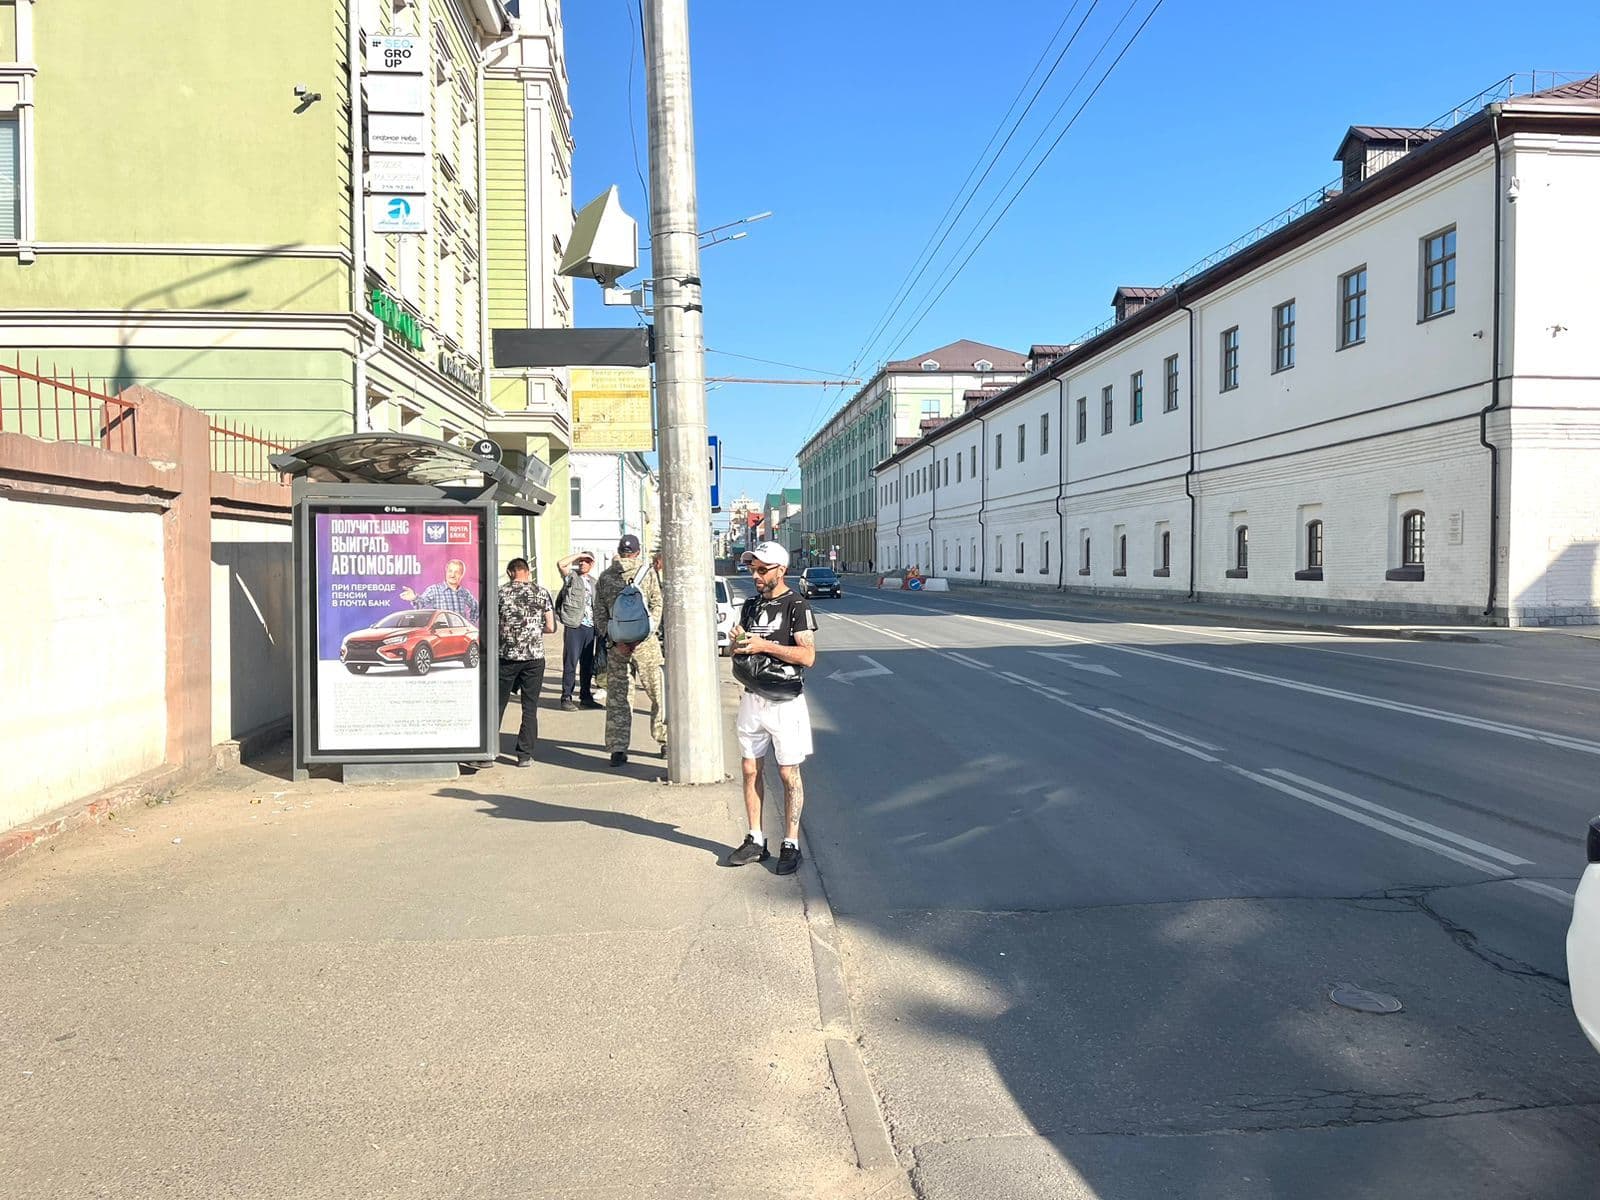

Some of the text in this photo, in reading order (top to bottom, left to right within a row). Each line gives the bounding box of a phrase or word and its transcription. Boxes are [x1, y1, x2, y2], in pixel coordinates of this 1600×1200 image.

[384, 49, 411, 58] GRO
[385, 59, 402, 68] UP
[331, 519, 409, 534] ПОЛУЧИТЕ ШАНС
[331, 536, 389, 553] ВЫИГРАТЬ
[331, 554, 421, 575] АВТОМОБИЛЬ
[351, 584, 396, 592] ПЕРЕВОДЕ
